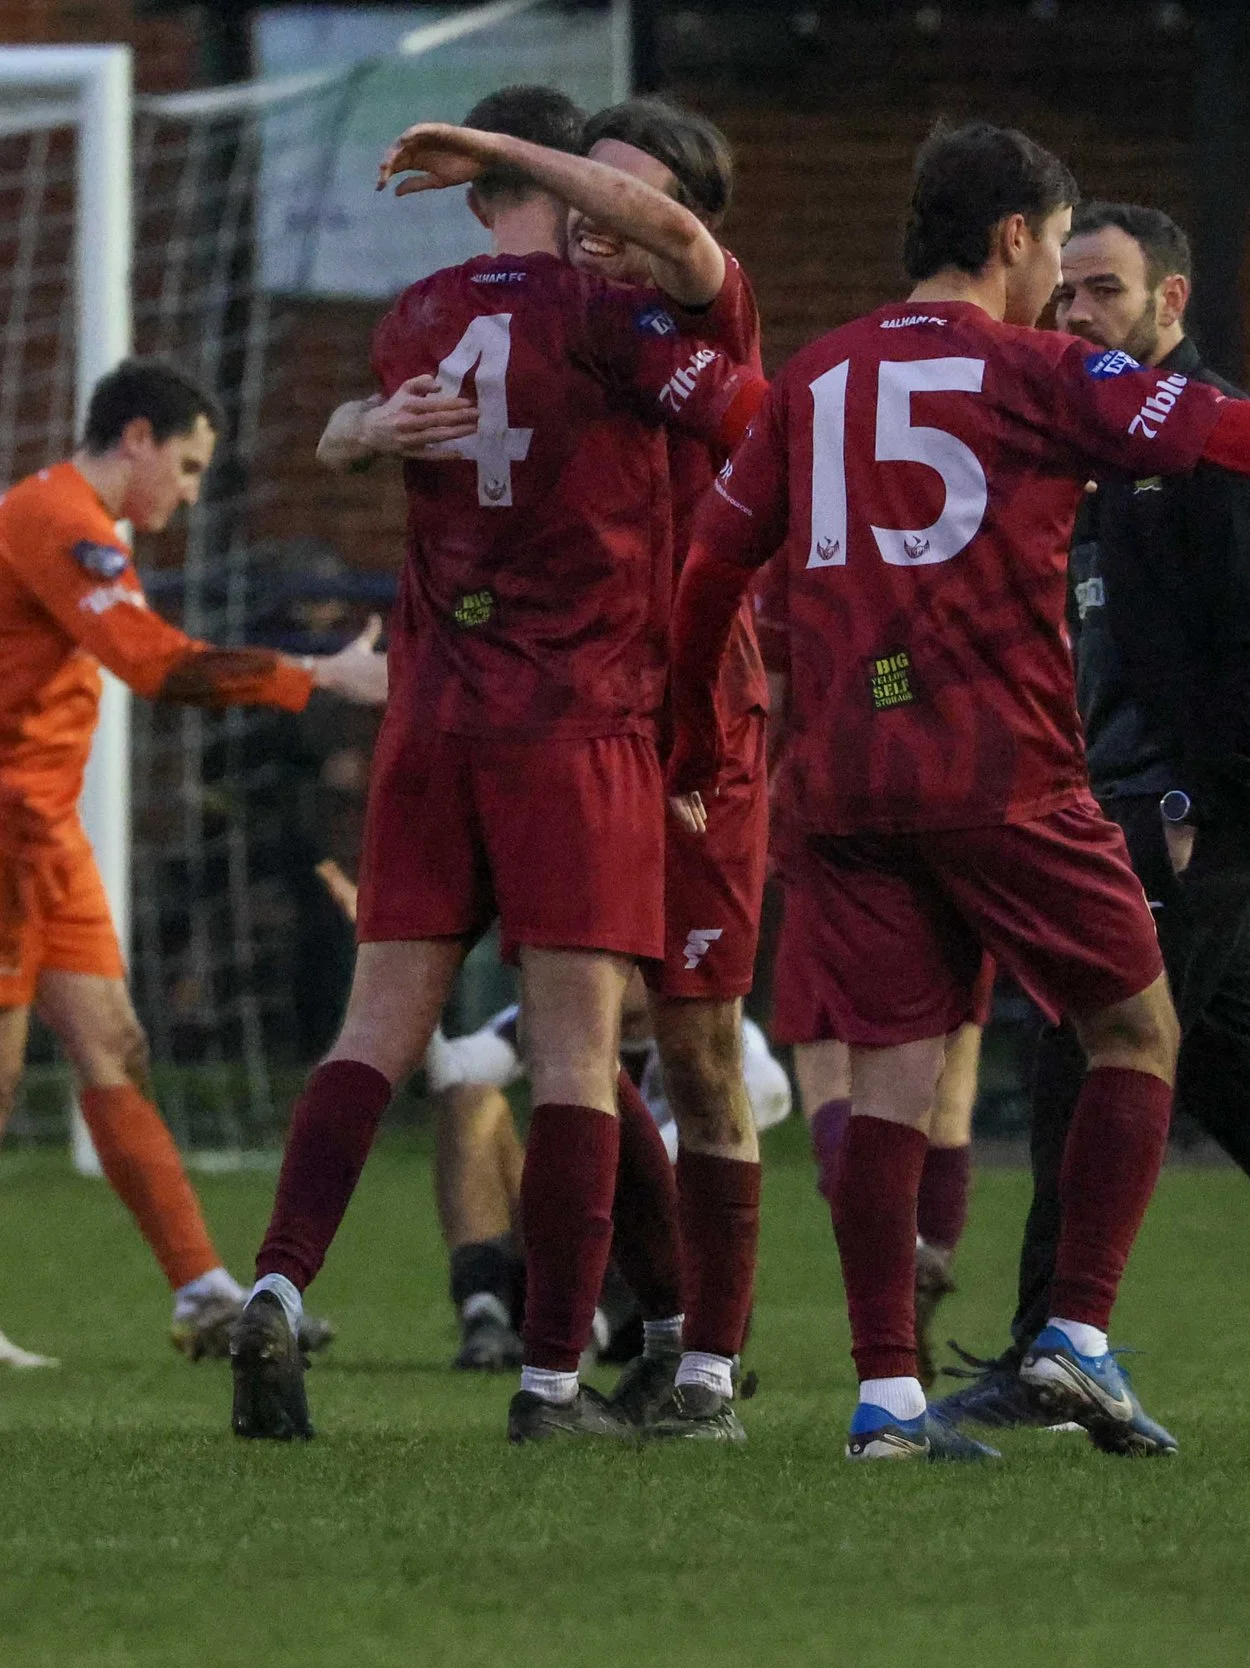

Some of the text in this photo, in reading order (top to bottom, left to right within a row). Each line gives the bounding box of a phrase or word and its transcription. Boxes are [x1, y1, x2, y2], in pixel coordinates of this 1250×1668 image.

[880, 316, 928, 328] BALHAM
[424, 313, 534, 506] 4
[805, 356, 988, 569] 15
[875, 652, 909, 675] BIG
[873, 678, 909, 699] SELF
